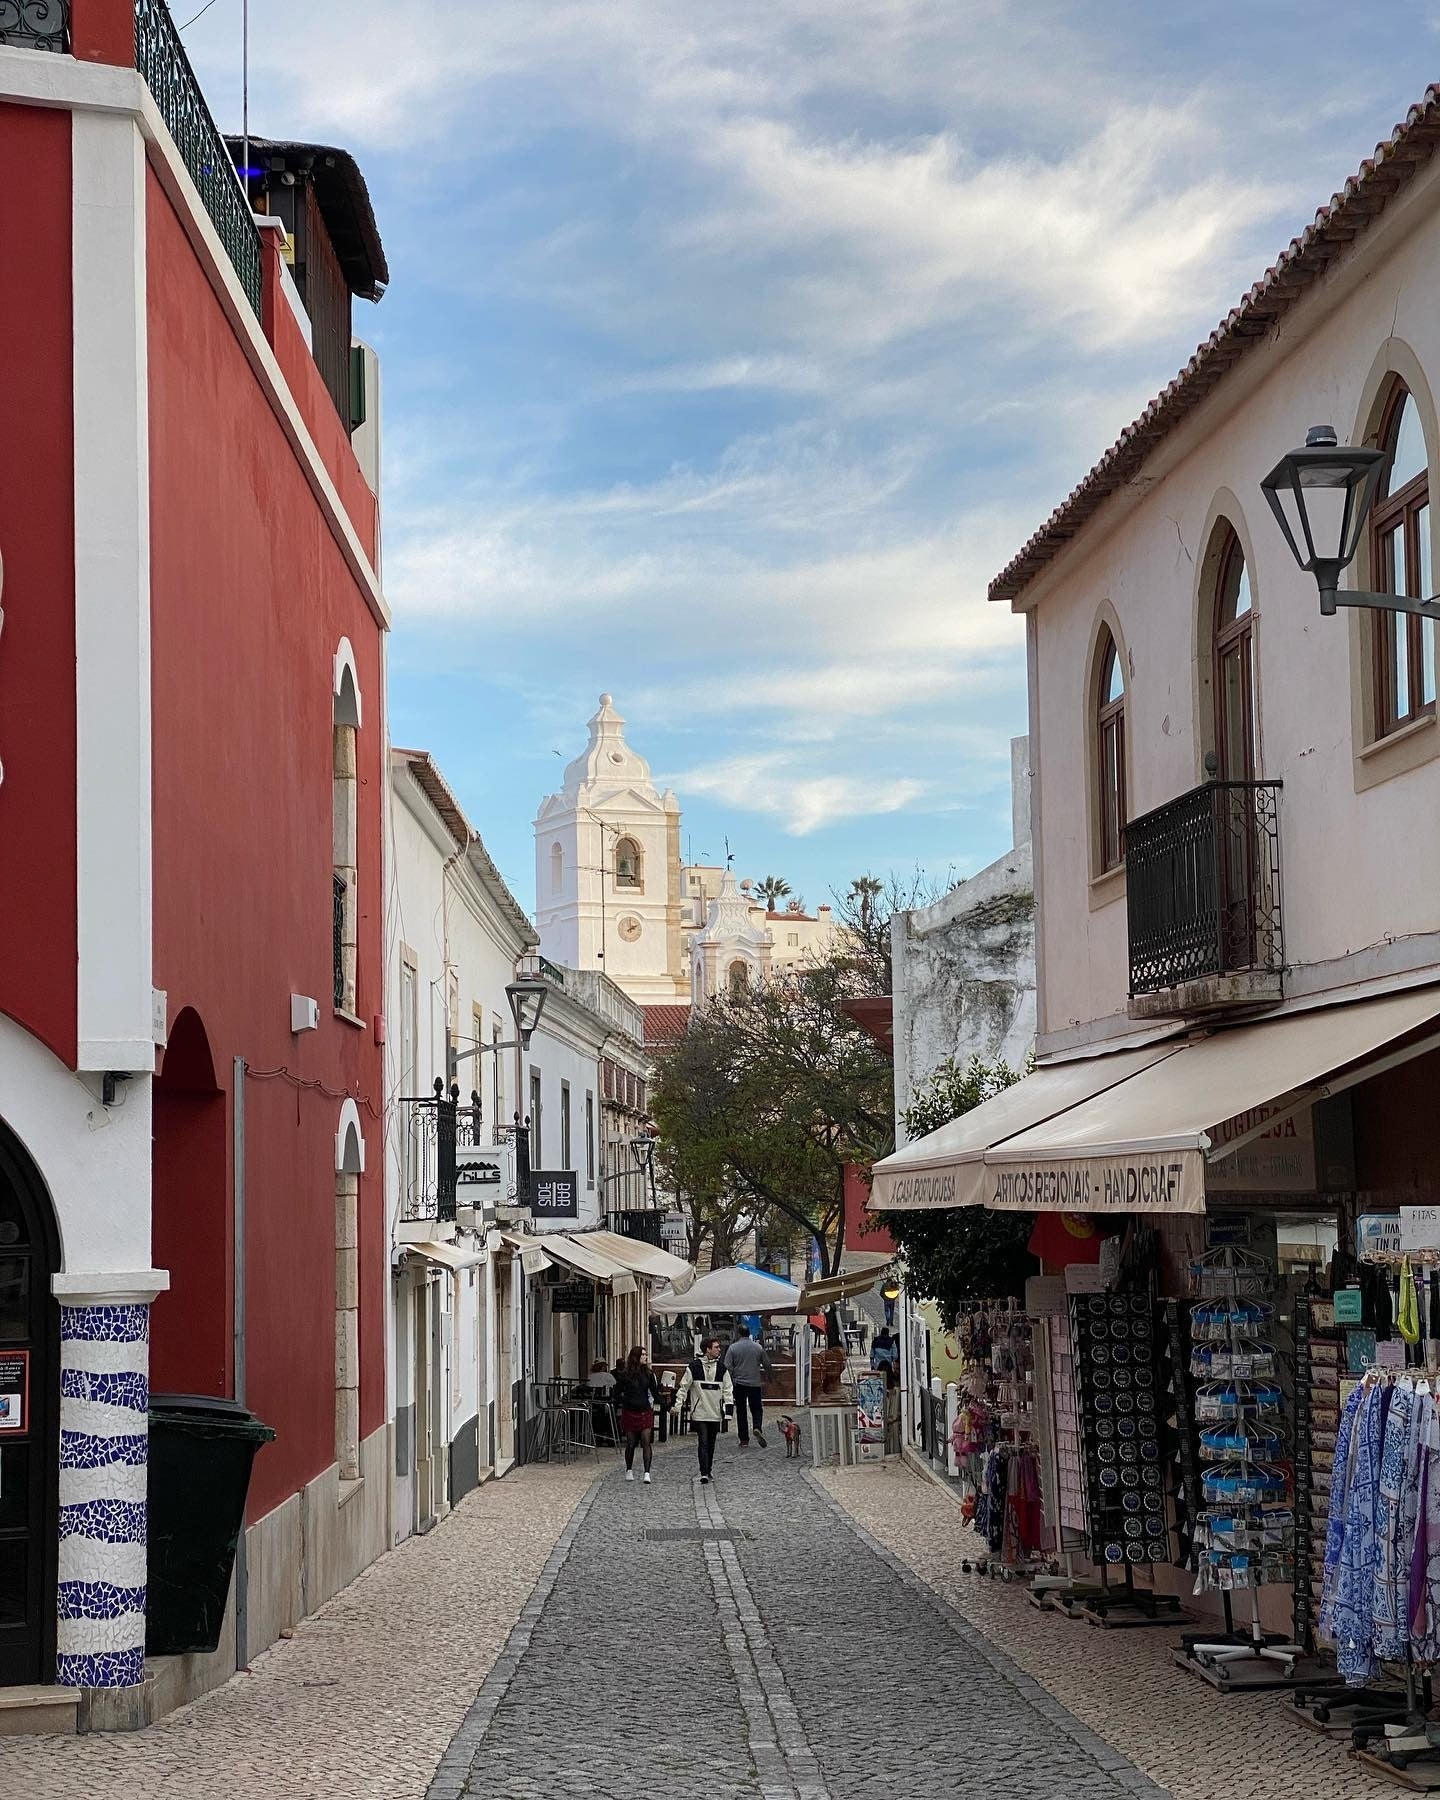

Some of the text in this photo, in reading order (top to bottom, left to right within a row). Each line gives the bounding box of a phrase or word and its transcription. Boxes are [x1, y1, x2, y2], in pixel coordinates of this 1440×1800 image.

[537, 1182, 552, 1207] SIDE
[556, 1182, 571, 1207] BAR
[913, 1176, 956, 1203] PORTUGUESA
[1035, 1170, 1090, 1203] REGIONAIS
[1103, 1164, 1183, 1203] HANDICRAFT
[1412, 1210, 1438, 1220] FITAS
[1375, 1237, 1390, 1251] TIN
